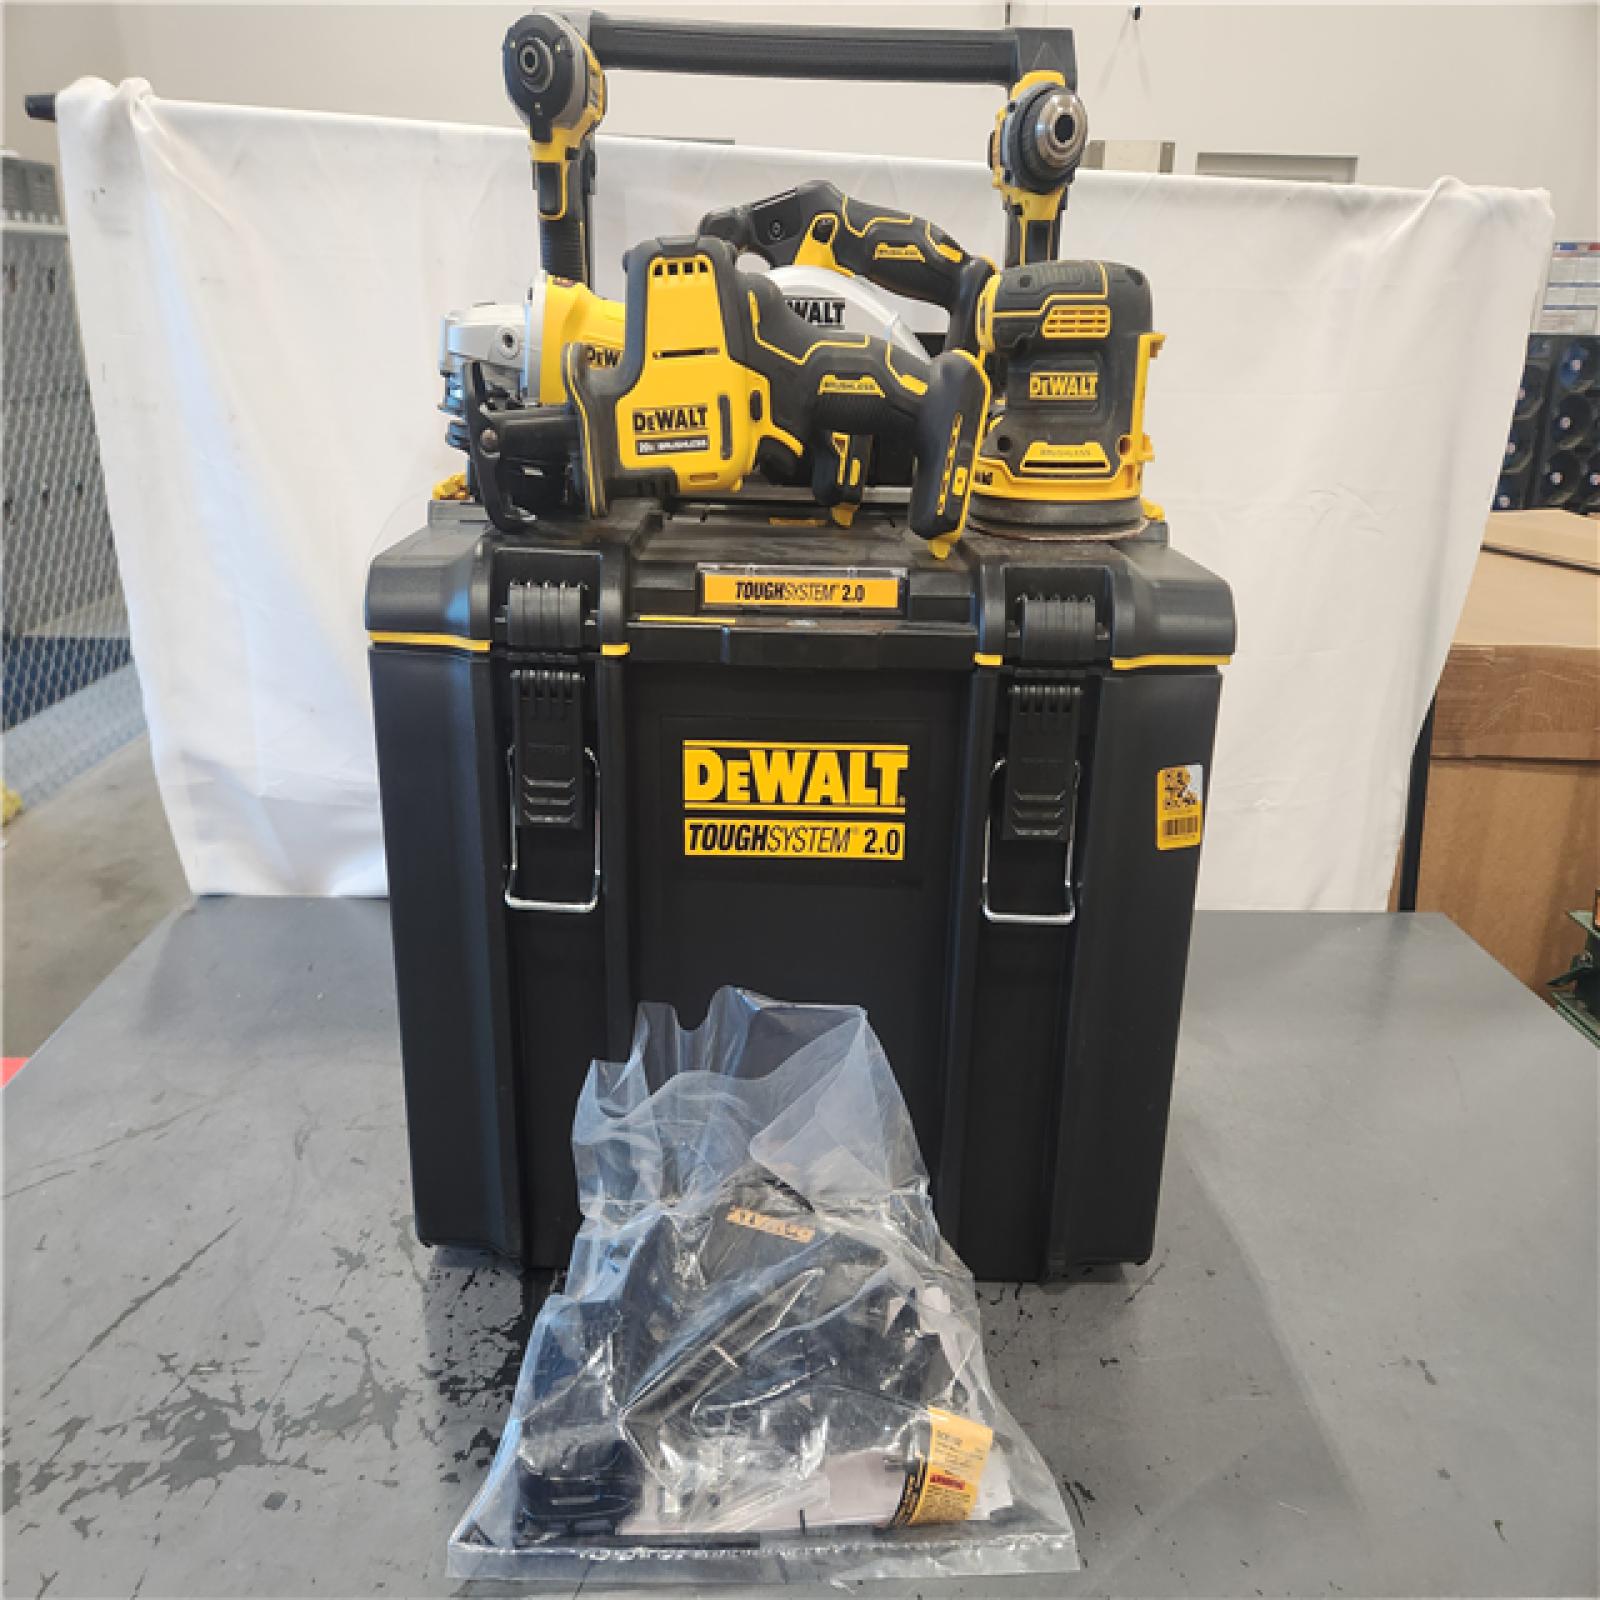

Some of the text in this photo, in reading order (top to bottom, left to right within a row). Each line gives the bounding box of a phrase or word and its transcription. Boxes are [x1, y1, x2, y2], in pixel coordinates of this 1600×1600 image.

[1029, 374, 1098, 397] DEWALT
[633, 406, 708, 431] DEWALT
[841, 584, 866, 603] 2.0
[684, 748, 908, 806] DEWALT
[689, 823, 901, 856] TOUGHSYSTEM 2.0
